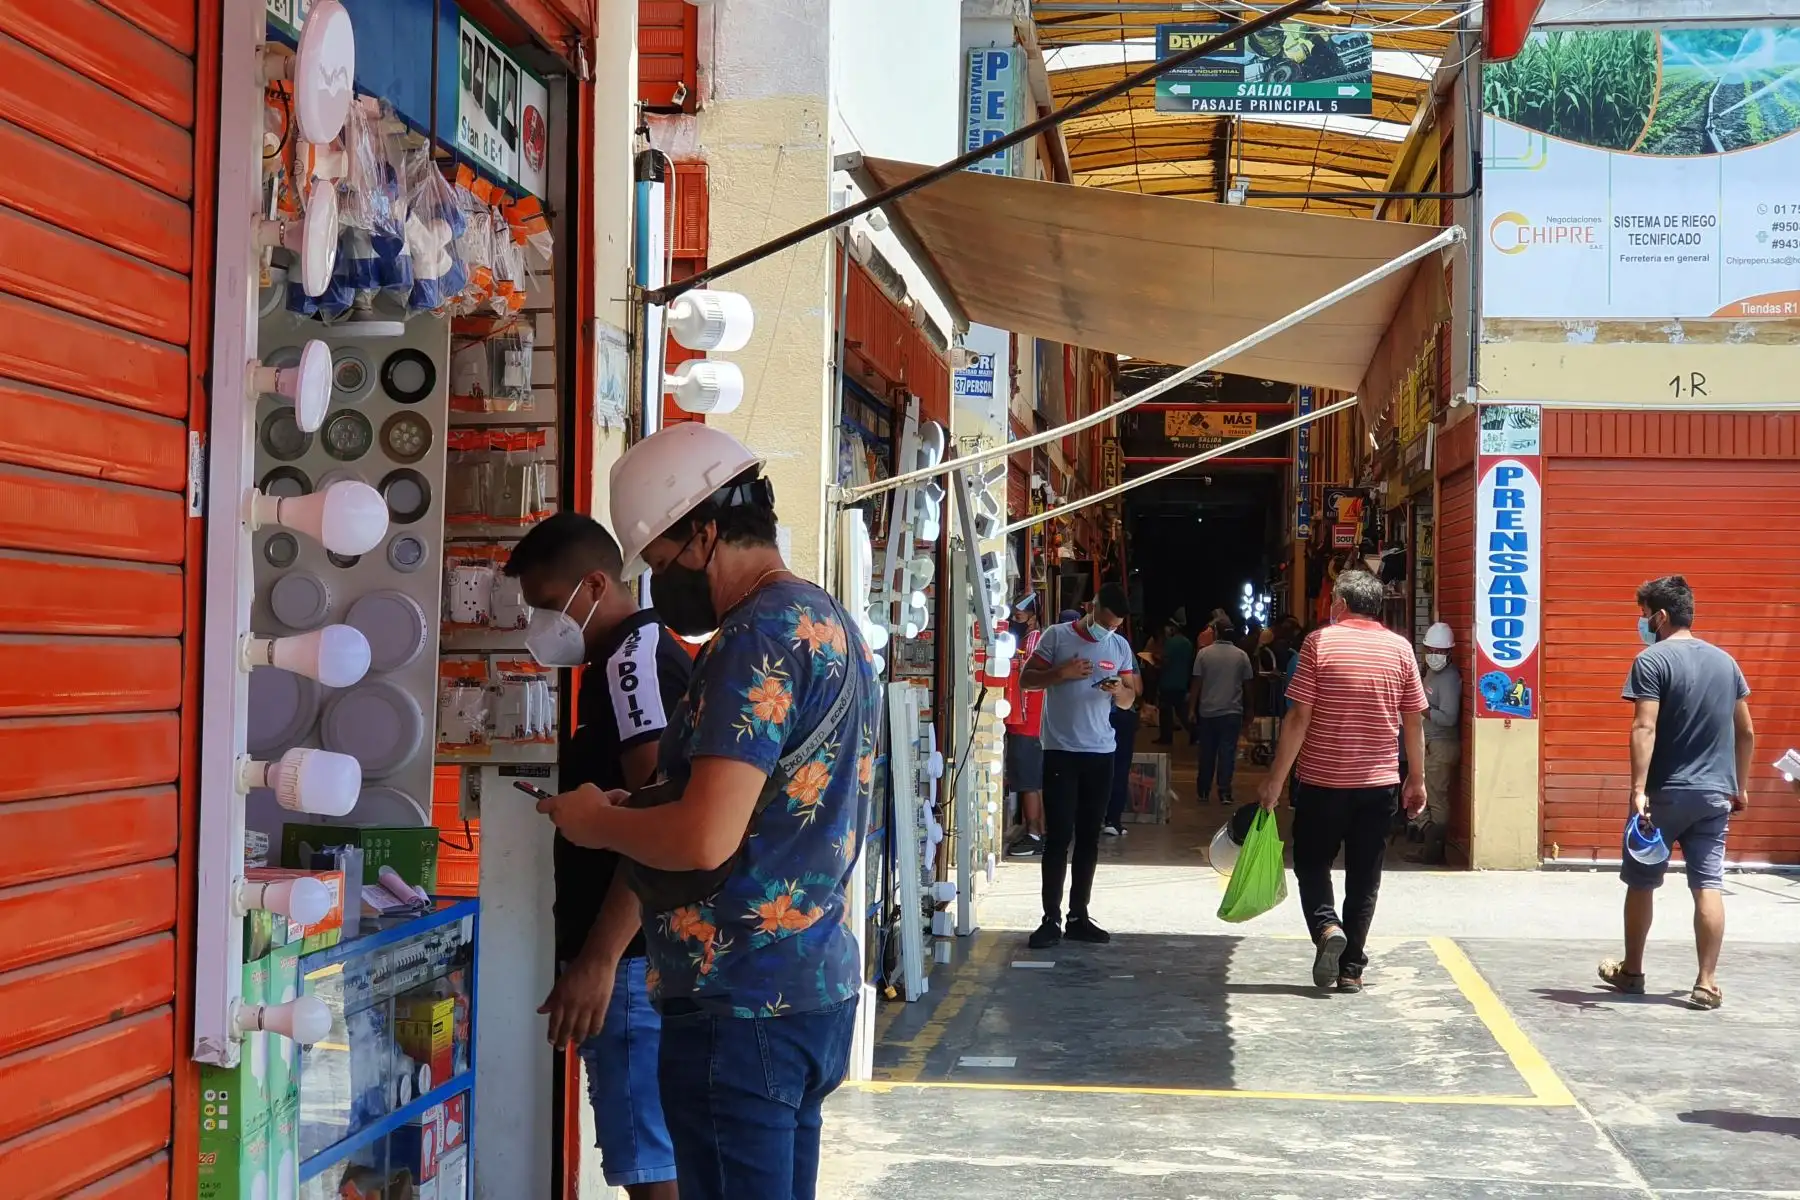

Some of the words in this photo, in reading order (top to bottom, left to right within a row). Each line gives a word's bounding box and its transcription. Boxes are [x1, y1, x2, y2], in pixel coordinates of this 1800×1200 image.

[970, 51, 984, 114] DRYWALL
[1237, 84, 1292, 97] SALIDA
[1192, 98, 1243, 111] PASAJE
[1250, 99, 1323, 111] PRINCIPAL
[1330, 100, 1338, 112] 5
[461, 115, 479, 148] Stan
[483, 132, 488, 157] 8
[490, 137, 502, 166] E-1
[1773, 204, 1786, 214] 01
[1546, 215, 1602, 225] Negociaciones
[1613, 215, 1661, 228] SISTEMA
[1663, 215, 1678, 228] DE
[1681, 215, 1716, 228] RIEGO
[1517, 226, 1596, 244] CHIPRE
[1628, 233, 1701, 246] TECNIFICADO
[1676, 254, 1710, 264] general
[1740, 302, 1781, 314] Tiendas
[1784, 302, 1798, 313] R1
[955, 379, 966, 392] 37
[1223, 412, 1253, 425] MÁS
[1488, 466, 1529, 661] PRENSADOS
[618, 661, 639, 692] DO
